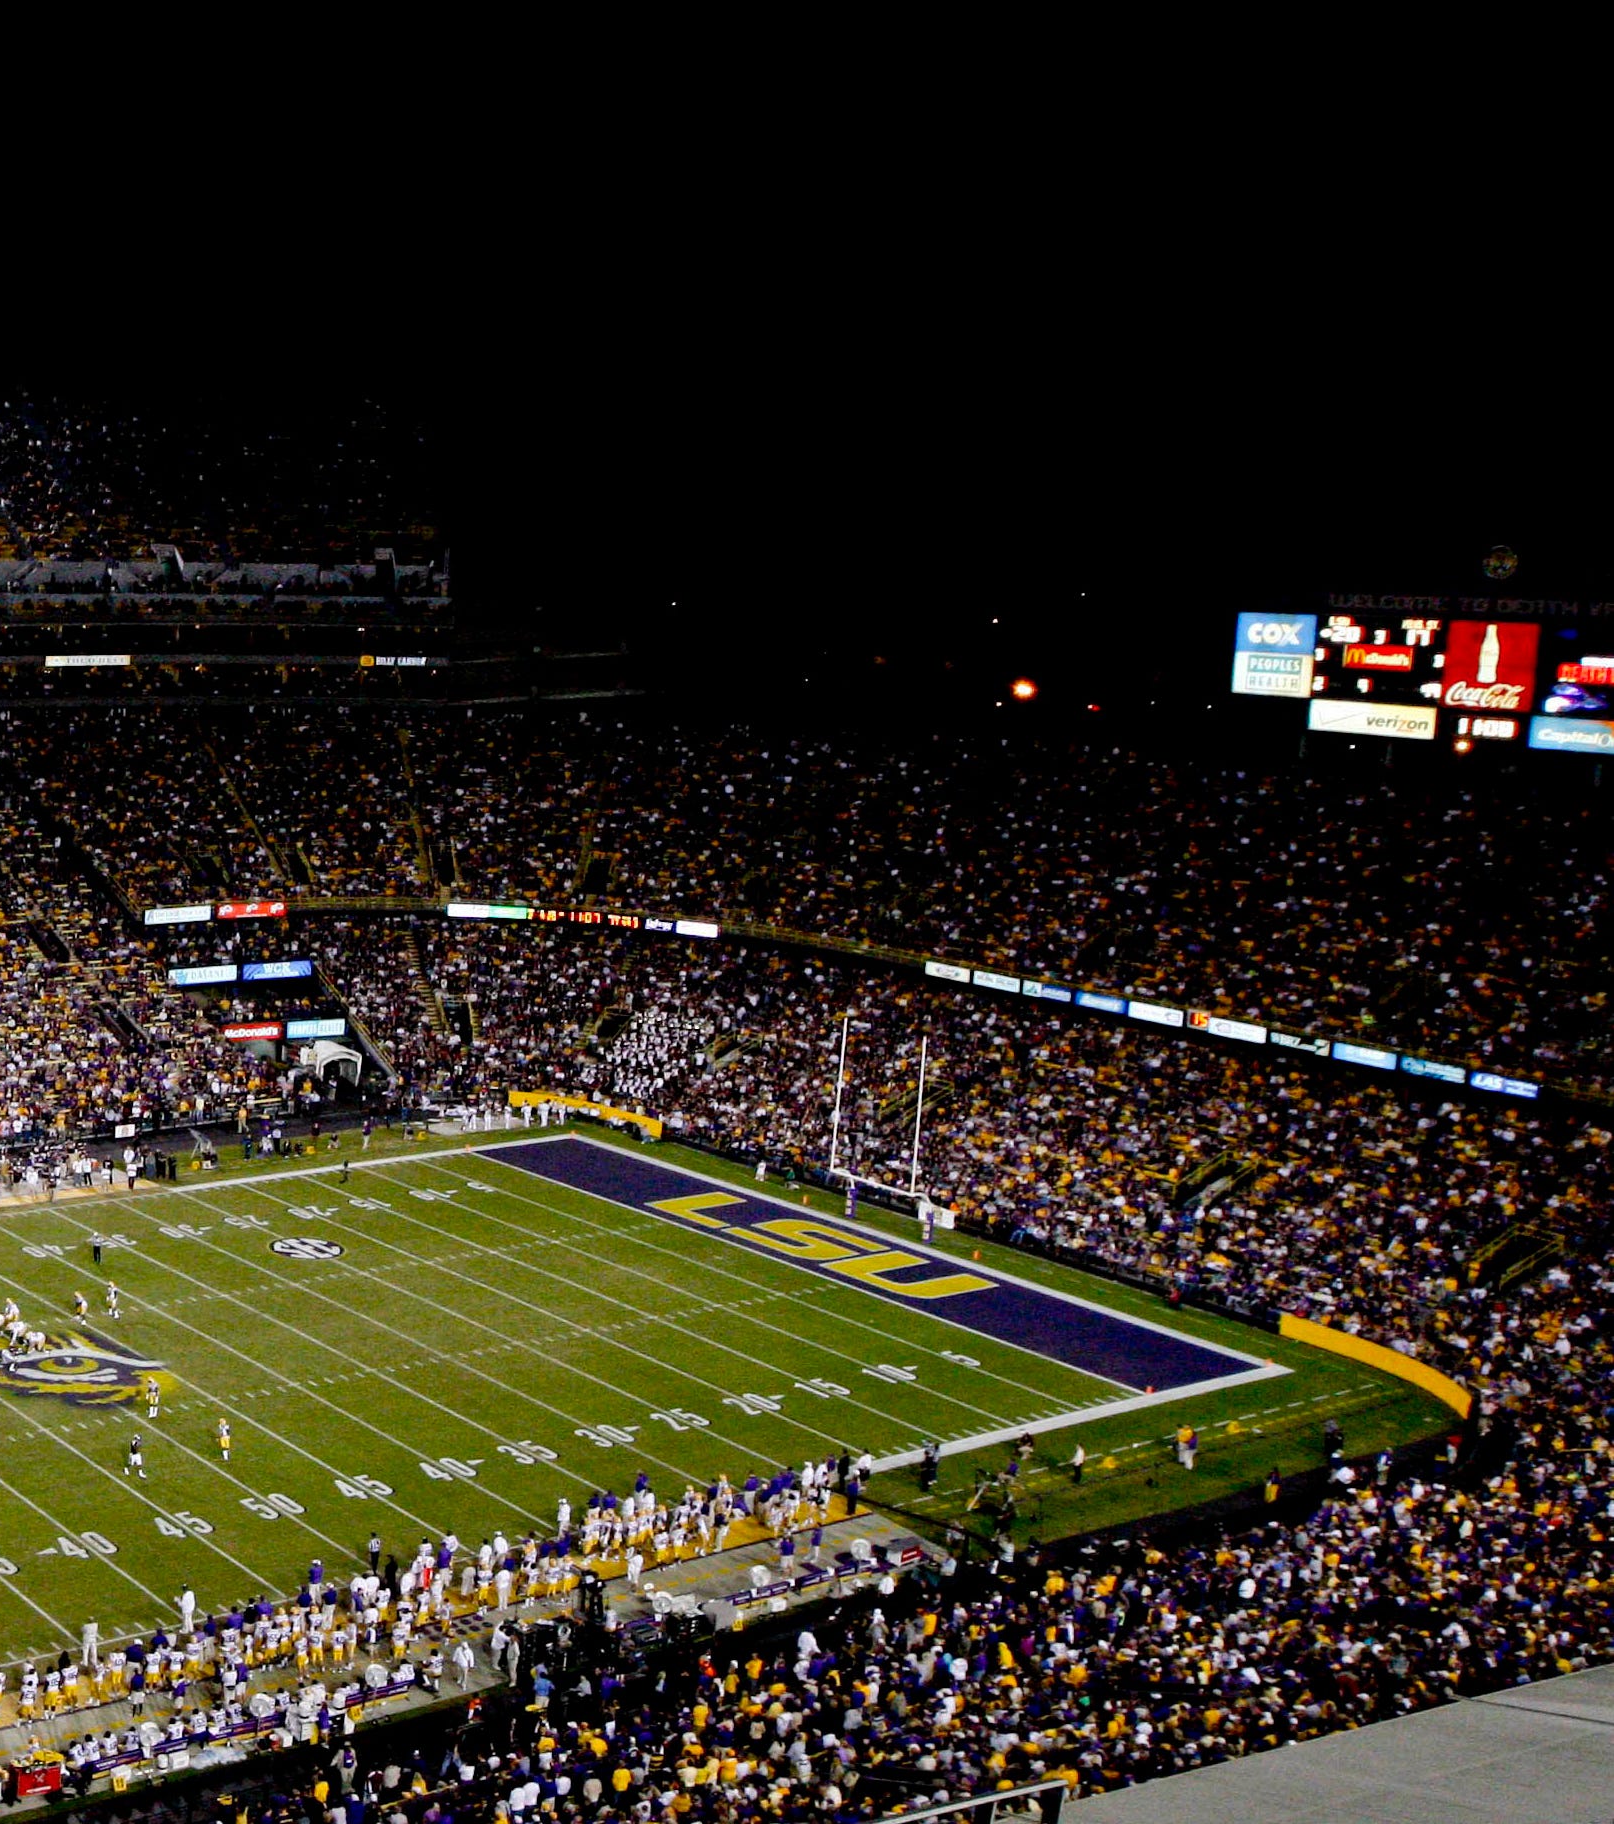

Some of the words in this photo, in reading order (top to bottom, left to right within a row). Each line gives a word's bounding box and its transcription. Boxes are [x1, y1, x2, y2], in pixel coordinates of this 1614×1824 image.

[1247, 622, 1304, 646] COX
[1249, 657, 1301, 671] PEOPLES
[1248, 675, 1299, 688] HEALTH
[1366, 714, 1429, 733] verizon
[224, 1026, 279, 1039] McDonald's
[408, 1188, 452, 1201] 10
[467, 1181, 494, 1192] 5
[287, 1205, 332, 1220] 20
[348, 1197, 392, 1210] 15
[158, 1223, 205, 1239] 30
[223, 1214, 270, 1229] 25
[21, 1243, 65, 1258] 40
[272, 1237, 343, 1260] SEC
[643, 1191, 999, 1300] LSU
[942, 1350, 981, 1367] 5
[861, 1363, 917, 1384] 10
[794, 1378, 851, 1399] 15
[723, 1394, 783, 1416] 20
[650, 1407, 712, 1431] 25
[574, 1424, 637, 1448] 30
[497, 1440, 560, 1466] 35
[418, 1456, 479, 1481] 40
[333, 1474, 395, 1502] 45
[240, 1493, 307, 1520] 50
[153, 1511, 215, 1538] 45
[56, 1531, 119, 1559] 40
